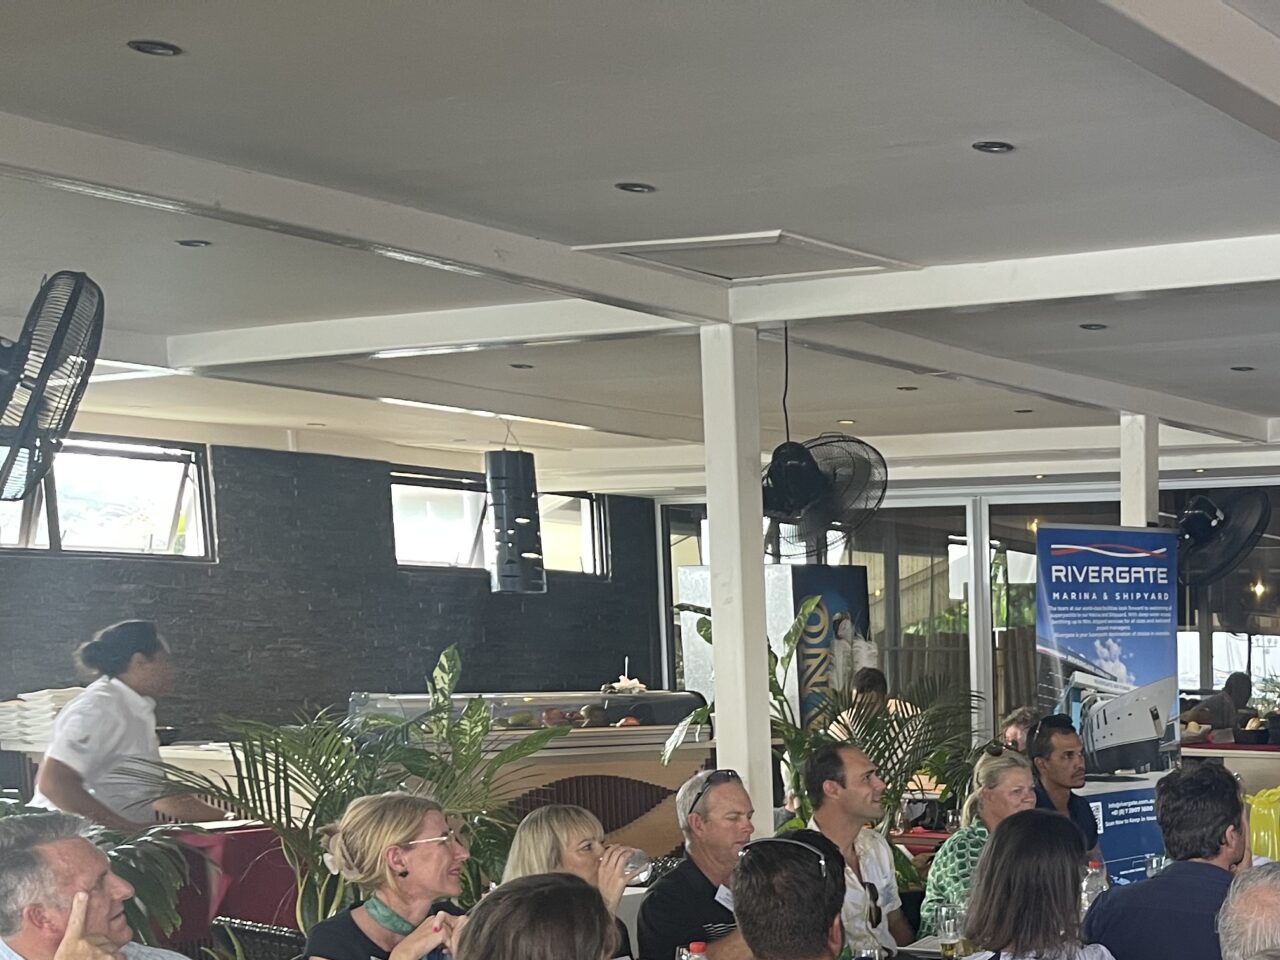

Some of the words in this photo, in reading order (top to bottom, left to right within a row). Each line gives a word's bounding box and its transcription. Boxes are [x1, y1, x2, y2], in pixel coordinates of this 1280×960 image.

[1051, 565, 1169, 584] RIVERGATE
[1052, 592, 1098, 600] MARINA
[1103, 592, 1108, 600] &
[1115, 592, 1169, 600] SHIPYARD
